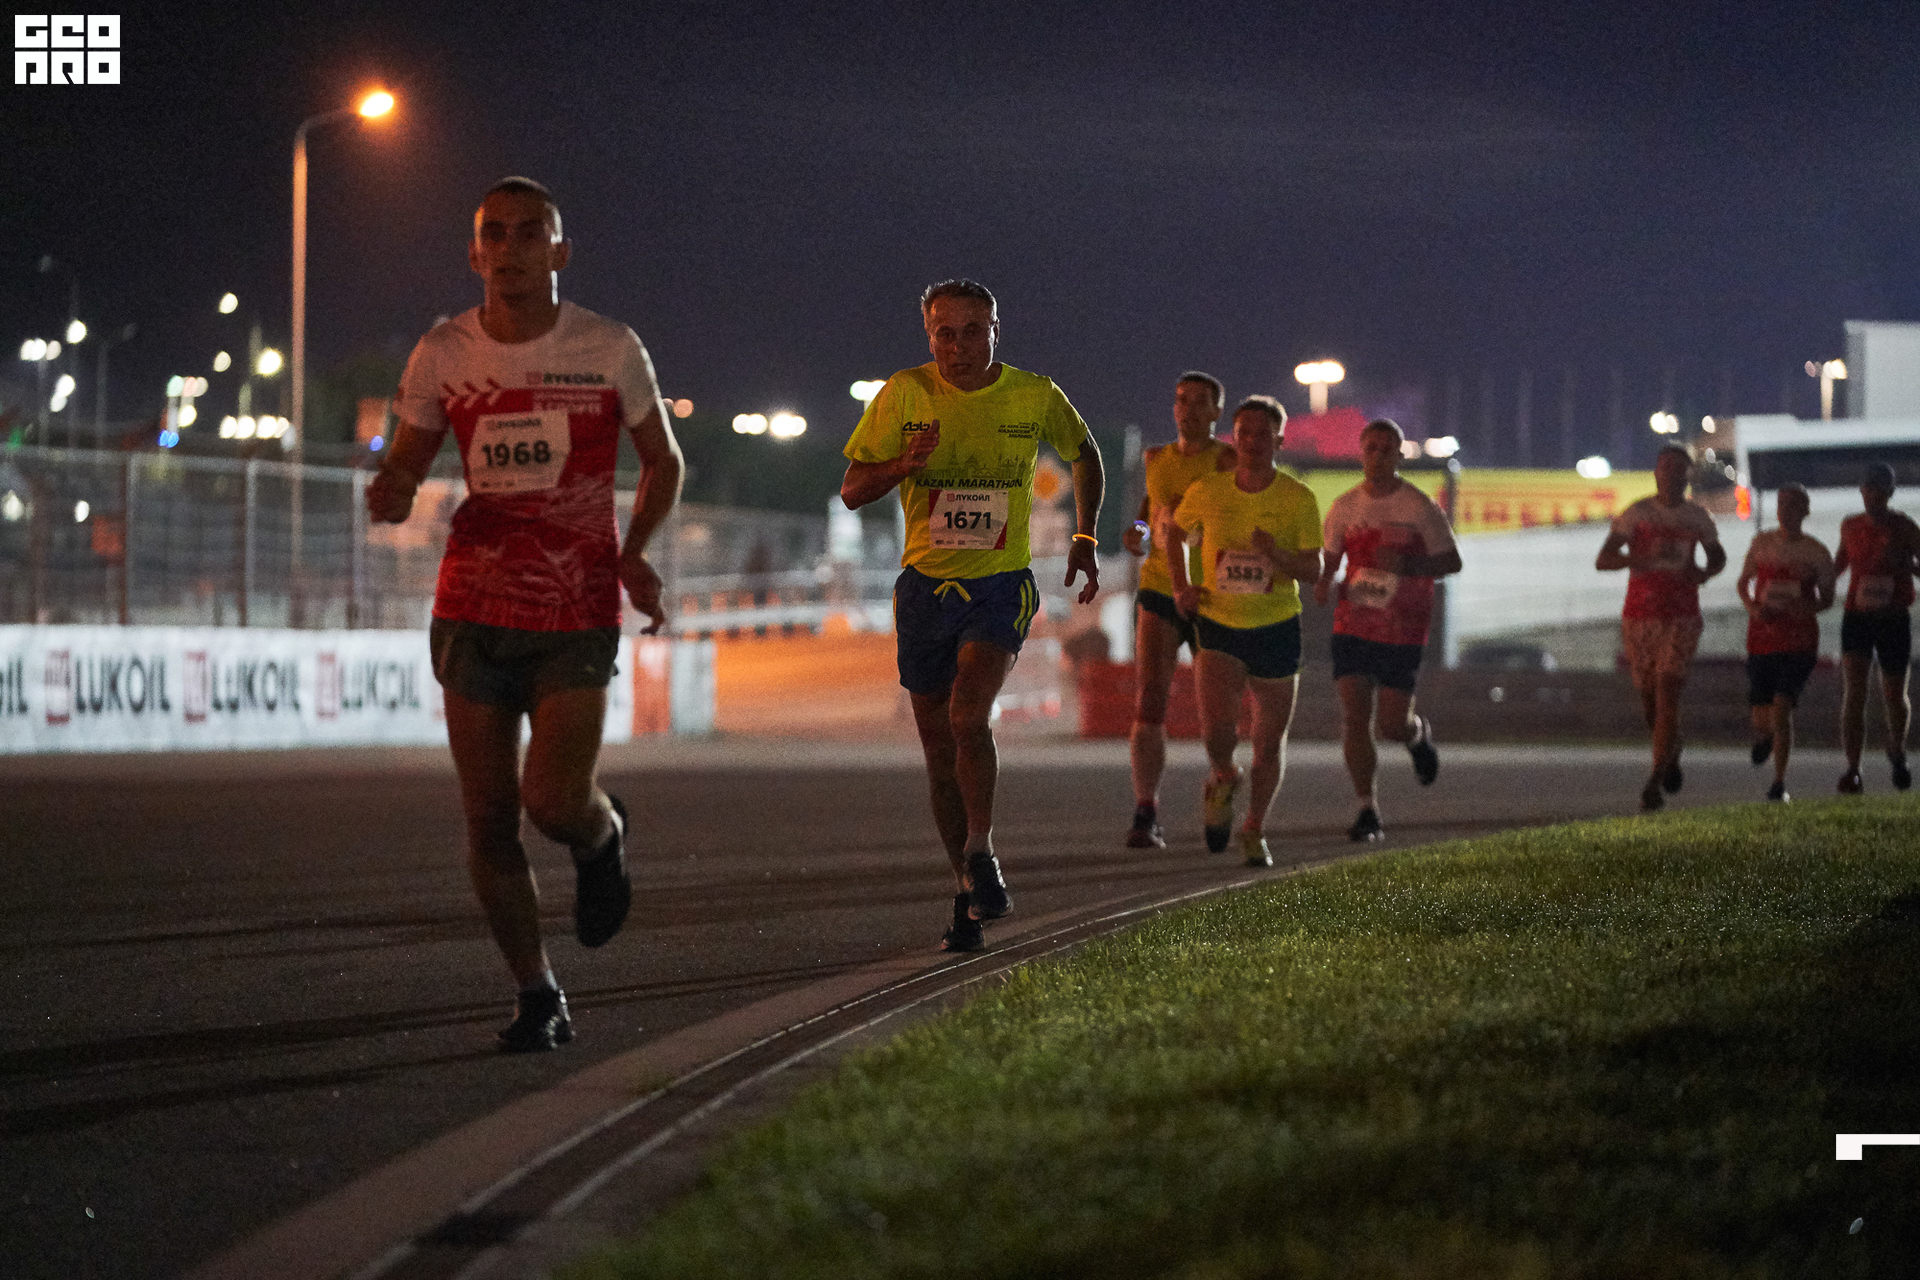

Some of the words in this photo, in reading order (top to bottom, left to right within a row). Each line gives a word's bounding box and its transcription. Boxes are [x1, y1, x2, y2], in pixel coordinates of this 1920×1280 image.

[481, 440, 551, 467] 1968
[915, 478, 955, 488] KAZAN
[957, 478, 1023, 489] MARATHON
[955, 493, 990, 502] ЛУКОЙЛ
[944, 511, 992, 530] 1671
[75, 652, 171, 713] LUKOIL
[211, 653, 301, 712] LUKOIL
